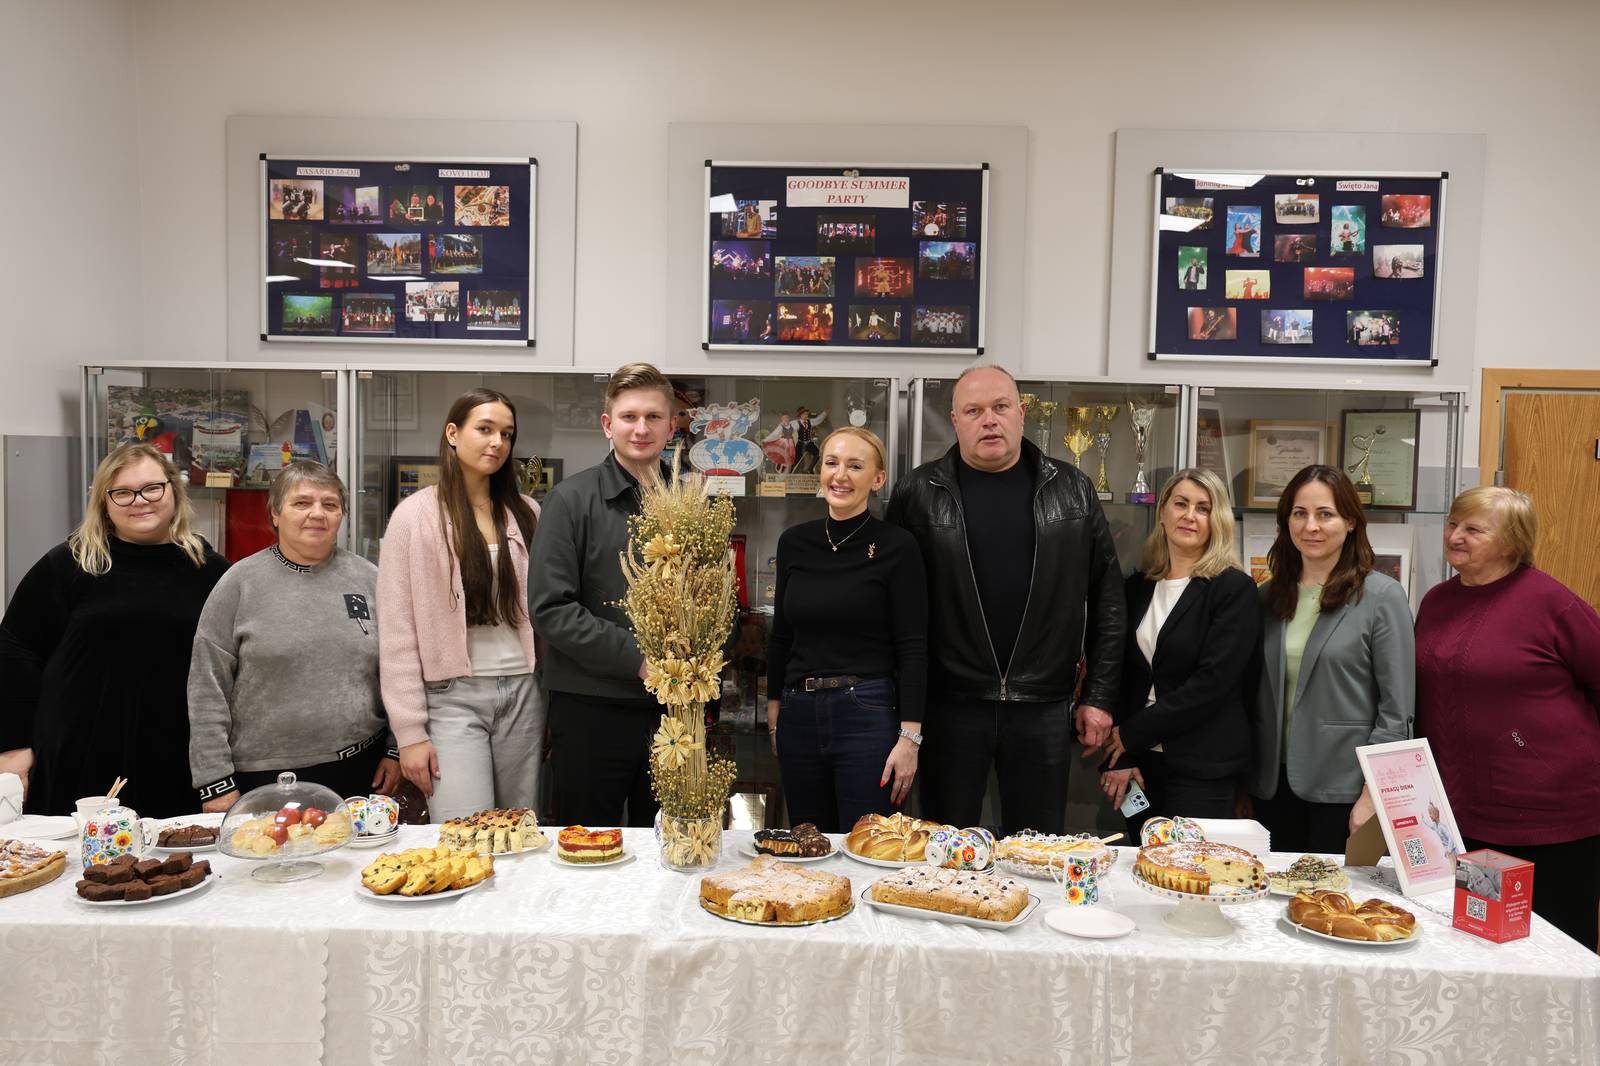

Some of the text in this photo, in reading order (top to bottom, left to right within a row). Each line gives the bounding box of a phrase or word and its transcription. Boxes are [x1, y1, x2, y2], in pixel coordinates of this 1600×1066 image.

[788, 180, 907, 190] GOODBYE SUMMER
[826, 194, 868, 204] PARTY
